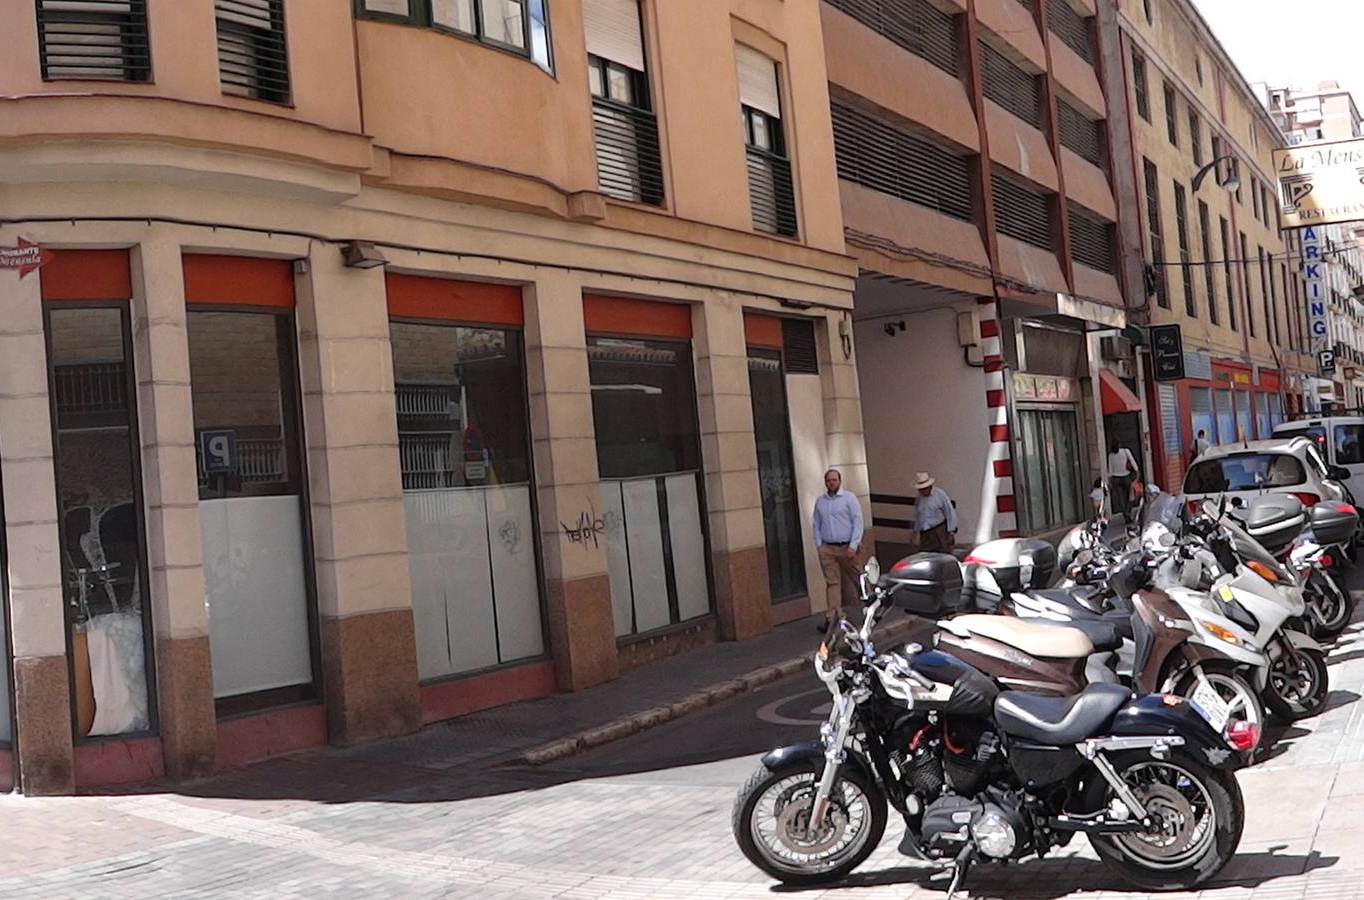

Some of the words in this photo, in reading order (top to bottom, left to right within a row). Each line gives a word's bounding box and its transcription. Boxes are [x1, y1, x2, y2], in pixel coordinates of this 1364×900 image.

[1312, 147, 1363, 169] Mens
[1299, 202, 1364, 221] RESTAURAN
[1303, 227, 1327, 335] ARKING
